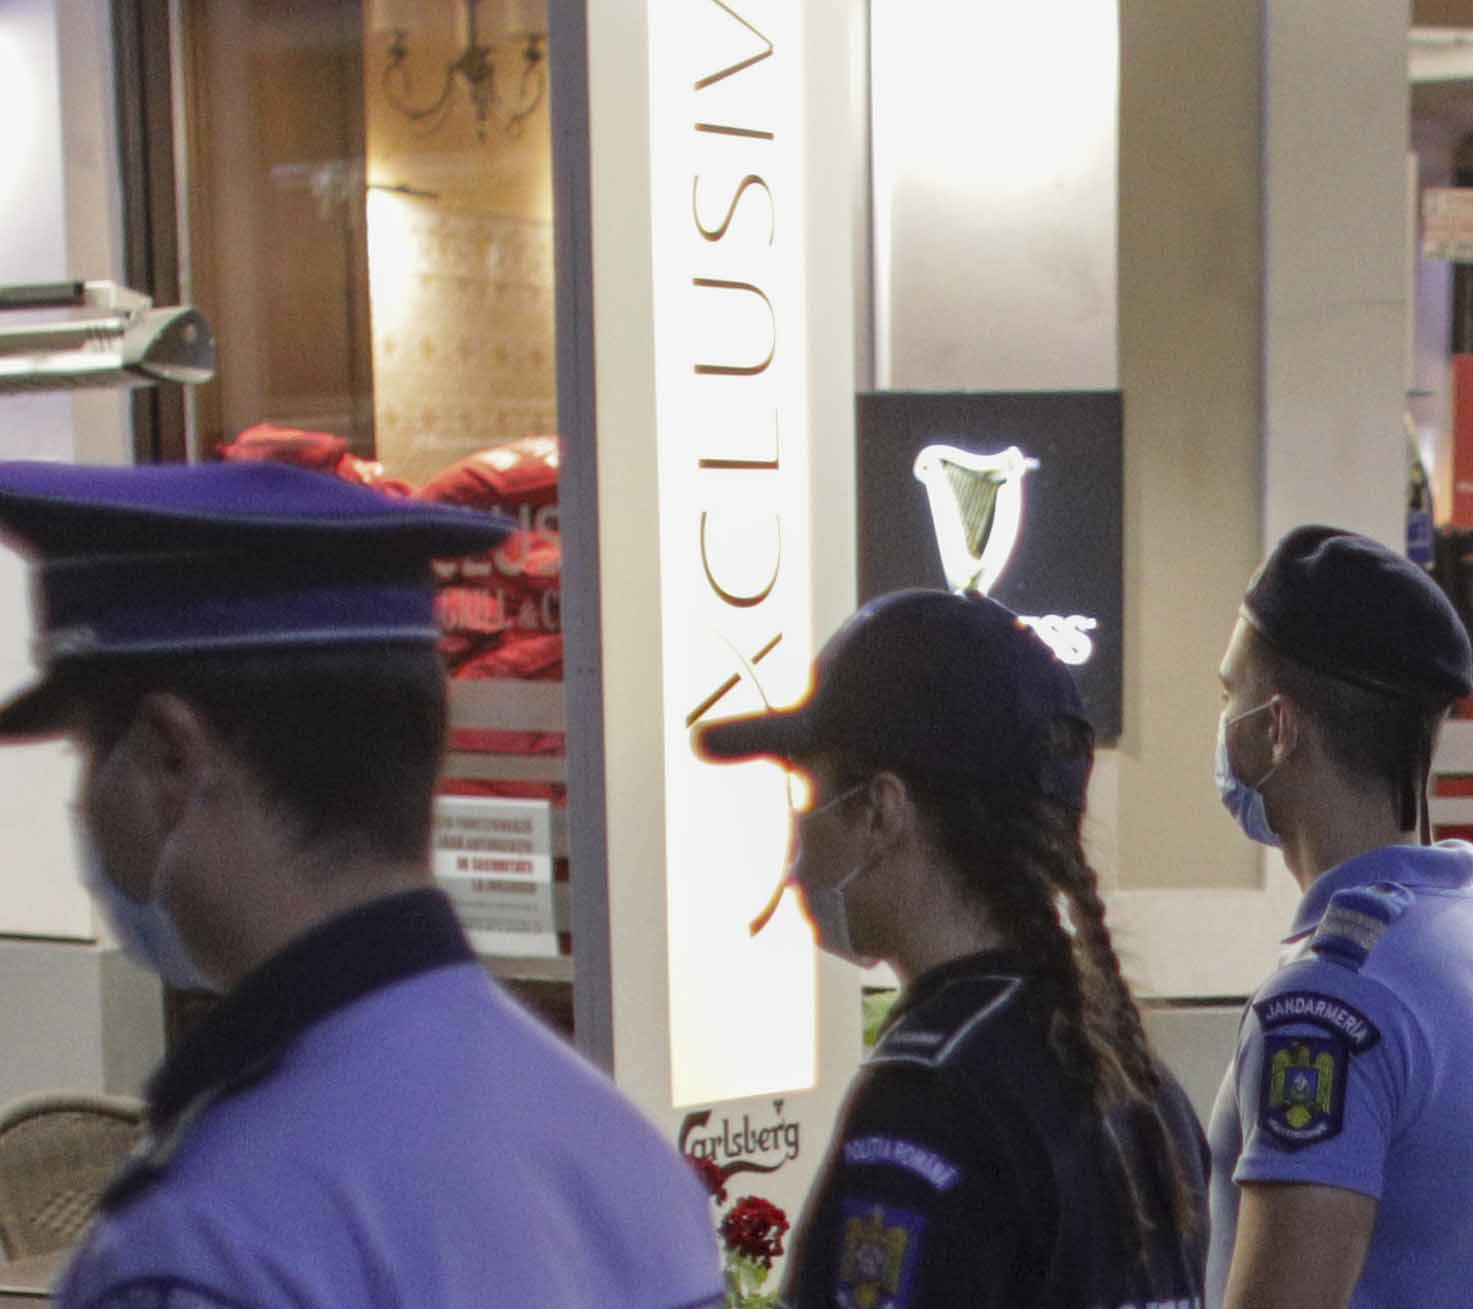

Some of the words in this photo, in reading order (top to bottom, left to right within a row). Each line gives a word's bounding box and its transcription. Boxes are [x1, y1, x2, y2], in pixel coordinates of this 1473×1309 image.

[685, 0, 792, 938] XCLUSIV
[1265, 998, 1368, 1043] JANDARMERIA
[679, 1106, 799, 1172] Carlsberg
